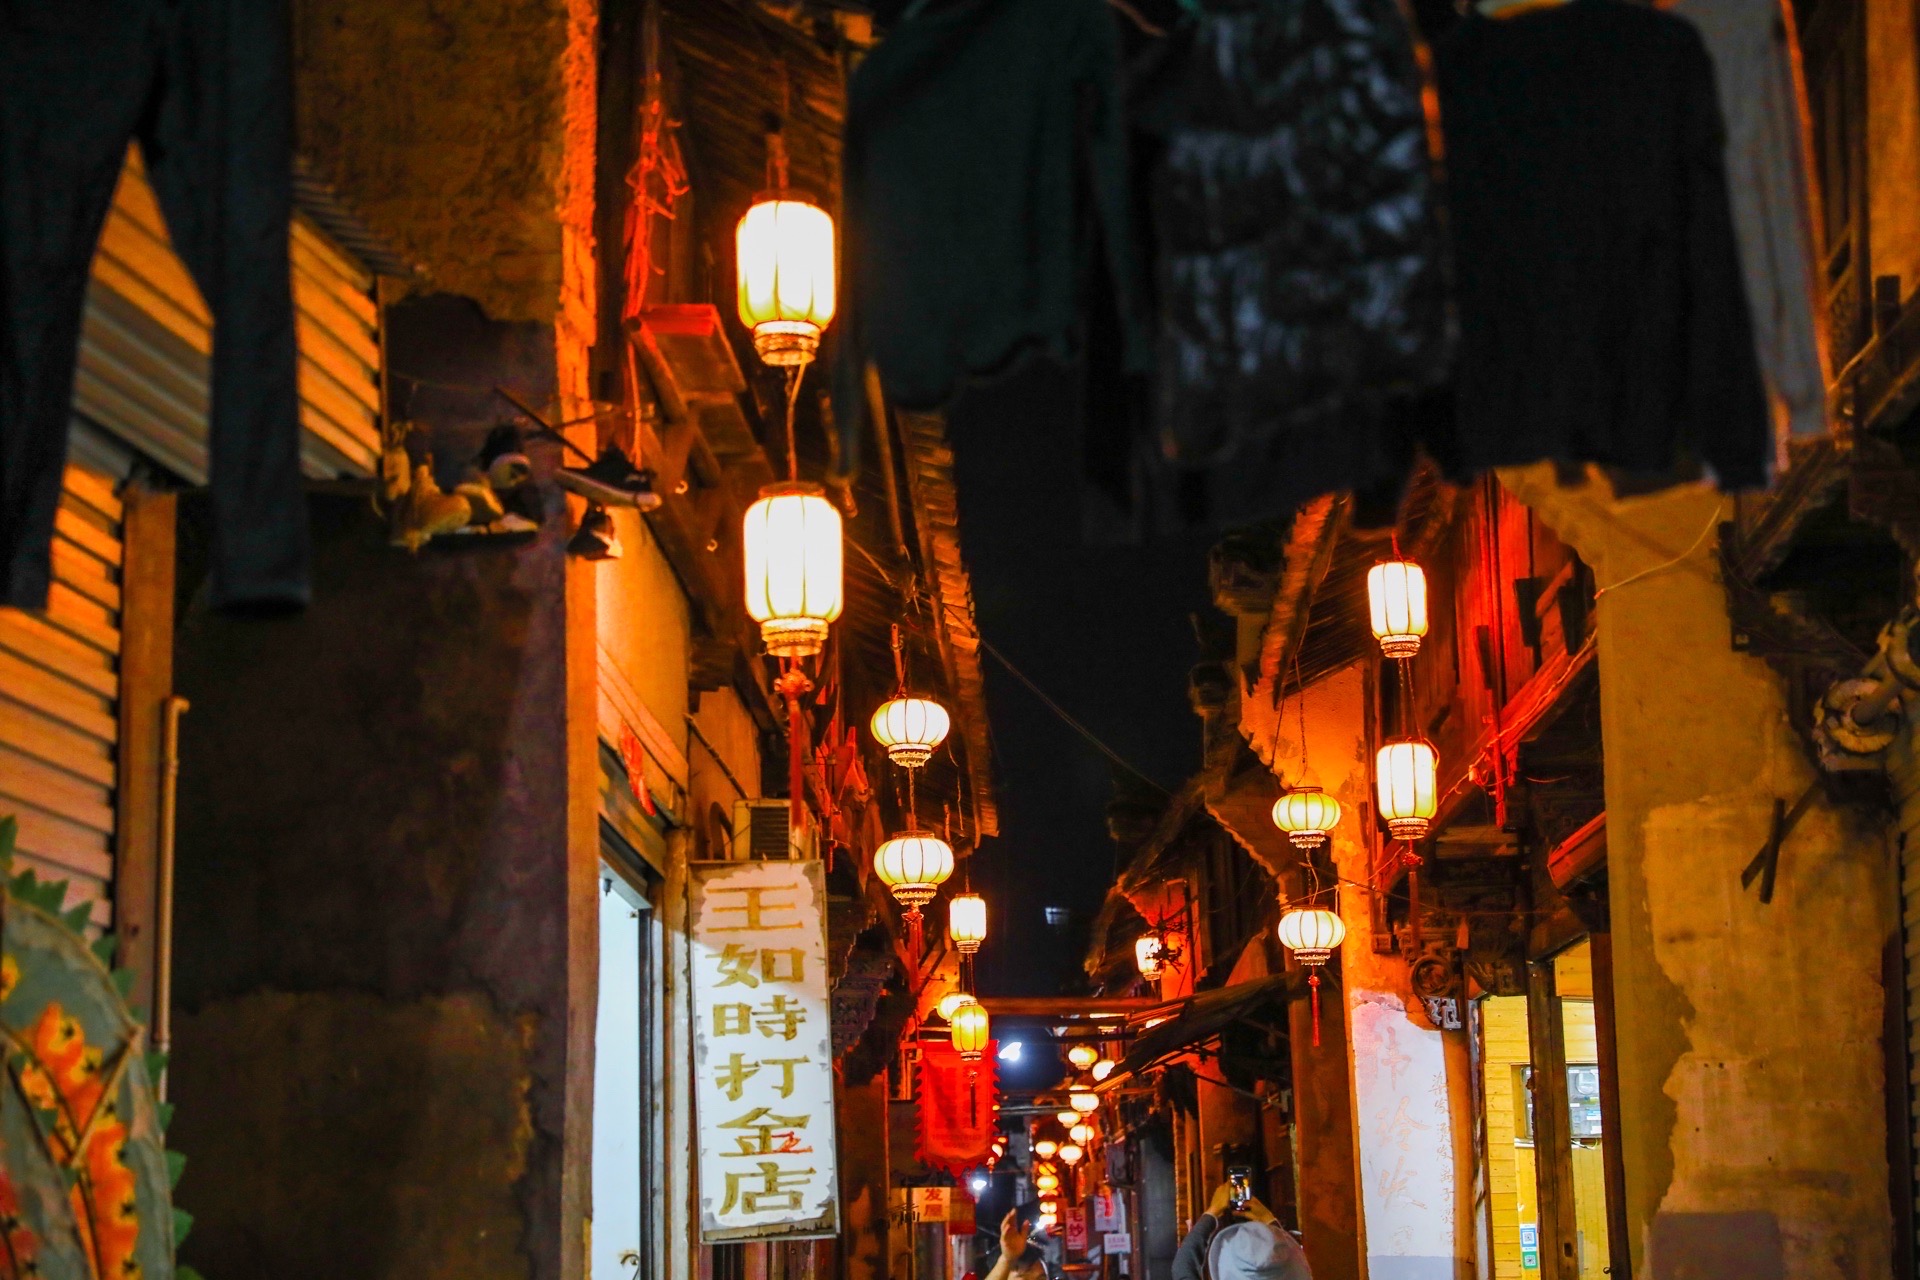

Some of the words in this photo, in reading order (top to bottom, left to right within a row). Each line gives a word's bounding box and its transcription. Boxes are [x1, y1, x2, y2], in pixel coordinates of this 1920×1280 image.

[704, 883, 816, 1216] 王如時打金店
